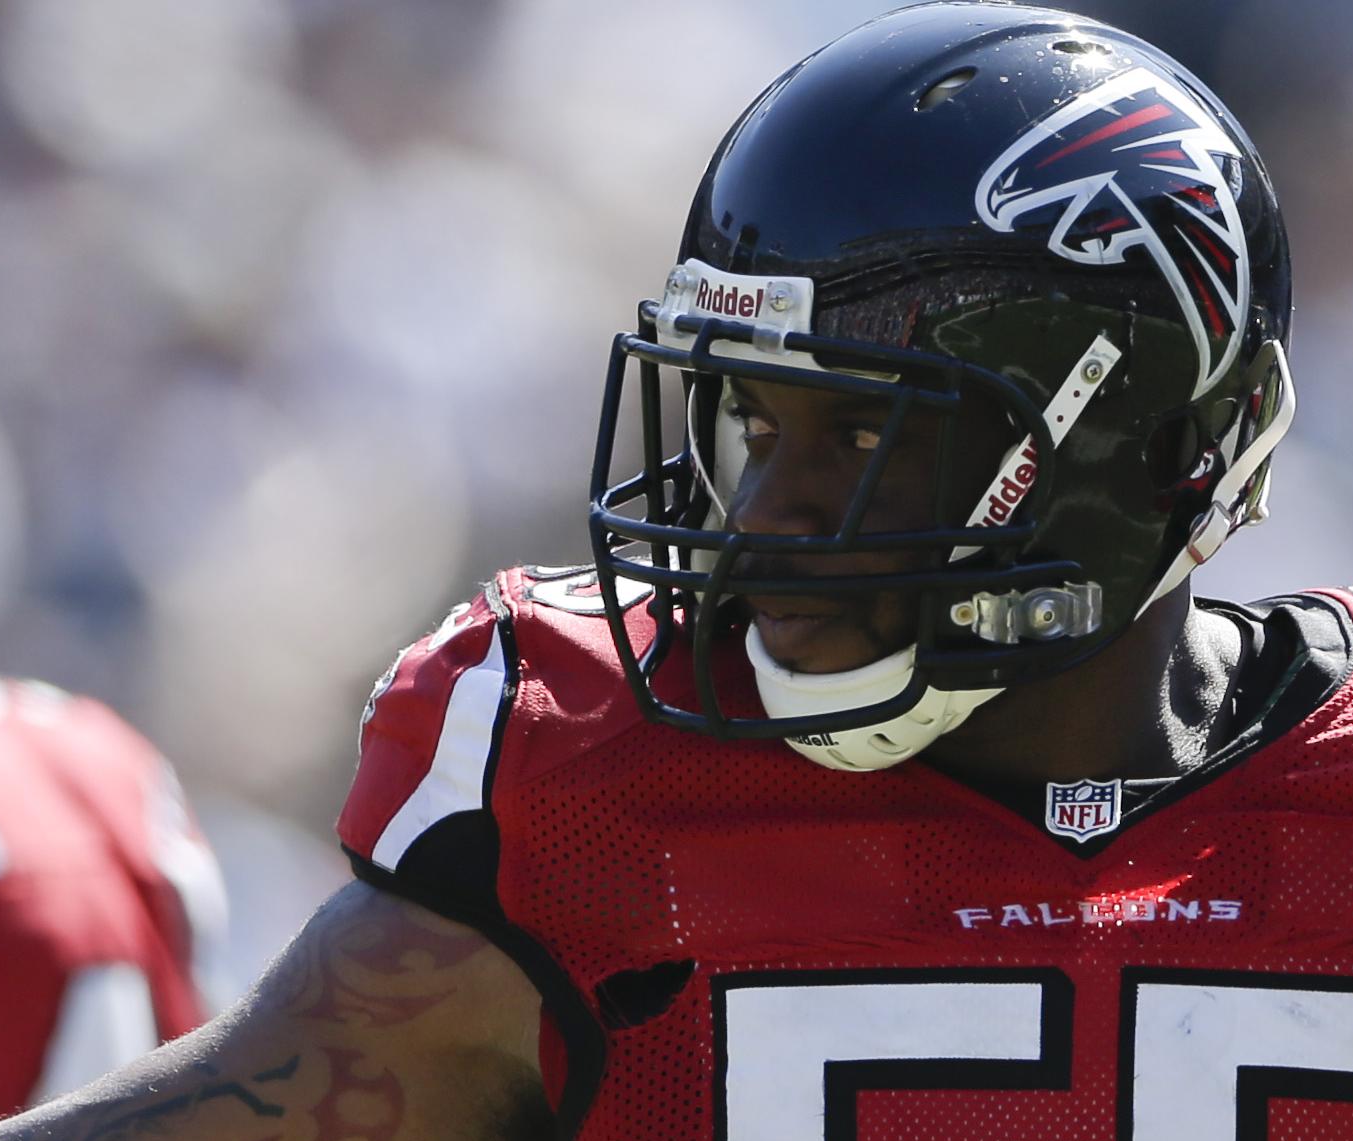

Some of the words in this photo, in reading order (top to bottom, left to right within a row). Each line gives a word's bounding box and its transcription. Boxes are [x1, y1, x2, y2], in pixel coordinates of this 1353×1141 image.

[696, 278, 768, 318] Riddel
[1057, 804, 1108, 830] NFL
[953, 899, 1243, 930] FALCONS
